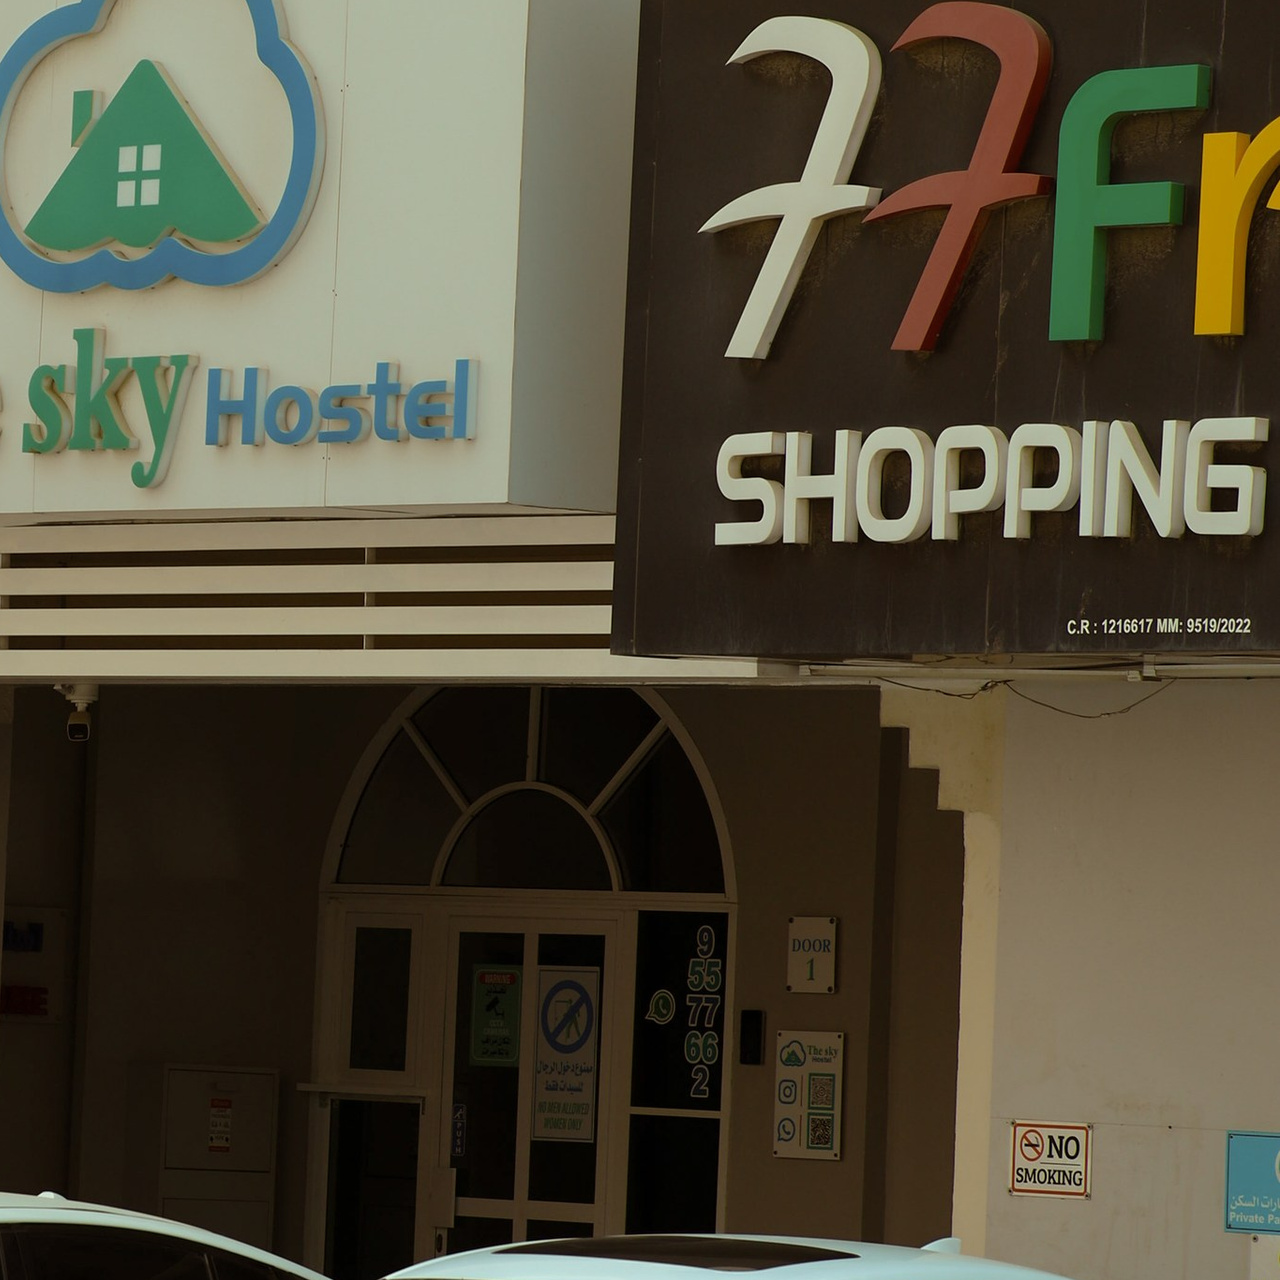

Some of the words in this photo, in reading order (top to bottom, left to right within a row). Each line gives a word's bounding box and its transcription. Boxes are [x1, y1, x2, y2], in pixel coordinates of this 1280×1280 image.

[22, 328, 200, 488] sky
[205, 358, 480, 446] Hostel
[714, 417, 1271, 546] SHOPPING
[1102, 619, 1154, 634] 1216617
[1156, 618, 1183, 633] MM:
[1186, 618, 1252, 633] 9519/2022
[696, 924, 716, 959] 9
[792, 938, 831, 954] DOOR
[686, 958, 722, 992] 55
[806, 958, 816, 981] 1
[685, 994, 721, 1028] 77
[684, 1030, 719, 1065] 66
[807, 1045, 822, 1055] The
[825, 1046, 838, 1058] sky
[690, 1064, 710, 1099] 2
[538, 1101, 547, 1113] NO
[562, 1103, 589, 1115] ALLOWED
[544, 1117, 567, 1130] WOMEN
[567, 1118, 583, 1130] ONLY
[1047, 1134, 1081, 1160] NO
[1015, 1167, 1084, 1187] SMOKING
[1230, 1195, 1260, 1210] السكن
[1230, 1211, 1265, 1224] Private
